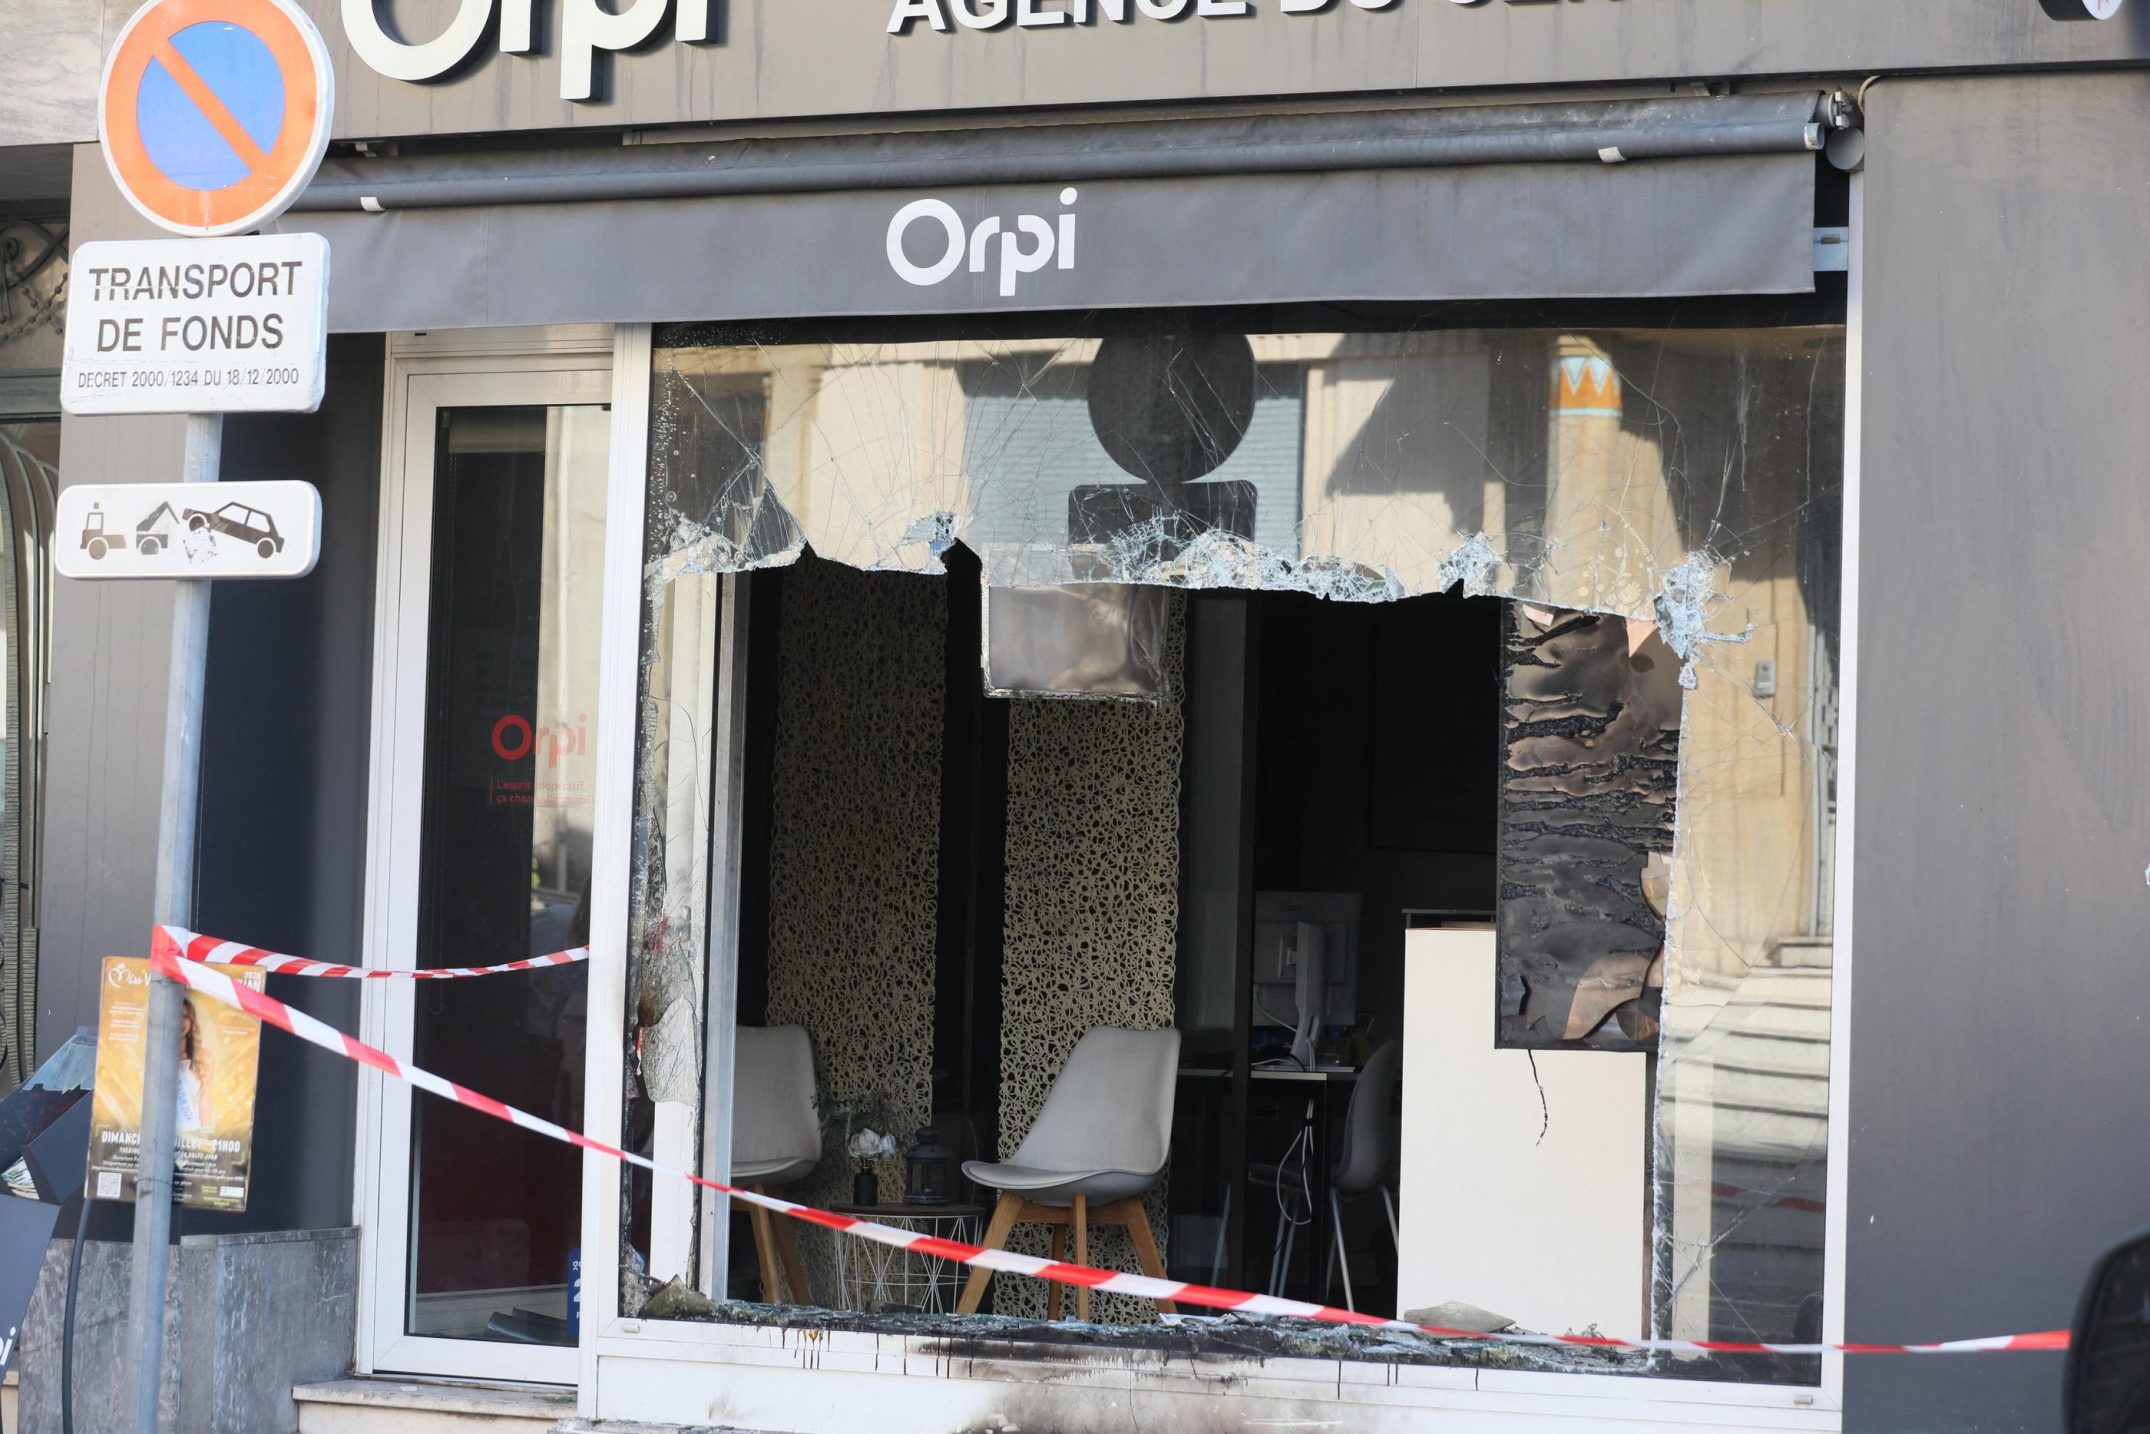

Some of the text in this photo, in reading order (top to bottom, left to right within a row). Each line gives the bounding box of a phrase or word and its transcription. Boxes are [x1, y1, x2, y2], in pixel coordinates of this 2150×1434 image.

[341, 0, 706, 100] Op
[886, 187, 1078, 296] Orpi
[89, 261, 303, 301] TRANSPORT
[97, 313, 284, 352] DE FONDS
[78, 367, 299, 388] DECRET 2000/1234 DU 18/12/2000
[491, 713, 588, 768] Orpi
